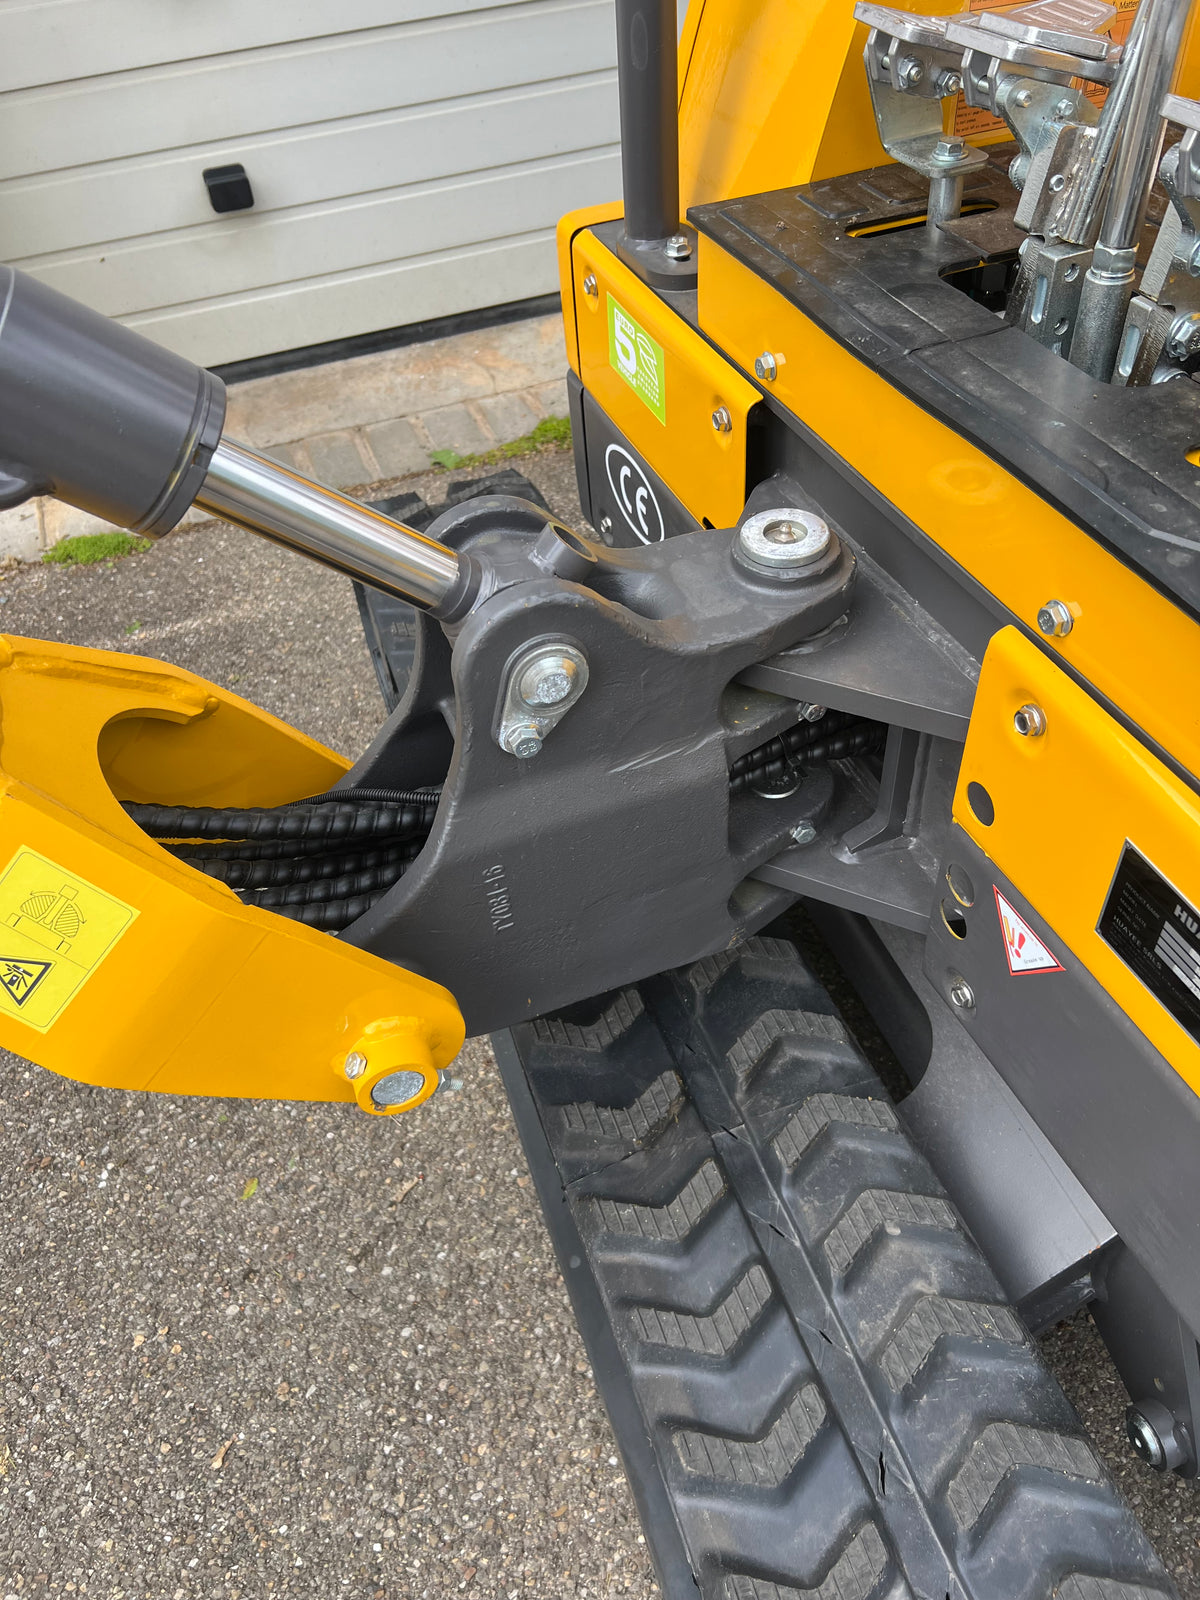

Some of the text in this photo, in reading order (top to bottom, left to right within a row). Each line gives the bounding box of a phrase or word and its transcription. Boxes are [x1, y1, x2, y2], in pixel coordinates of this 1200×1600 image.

[614, 307, 637, 375] 5
[615, 310, 634, 337] EURO
[619, 465, 648, 536] CE
